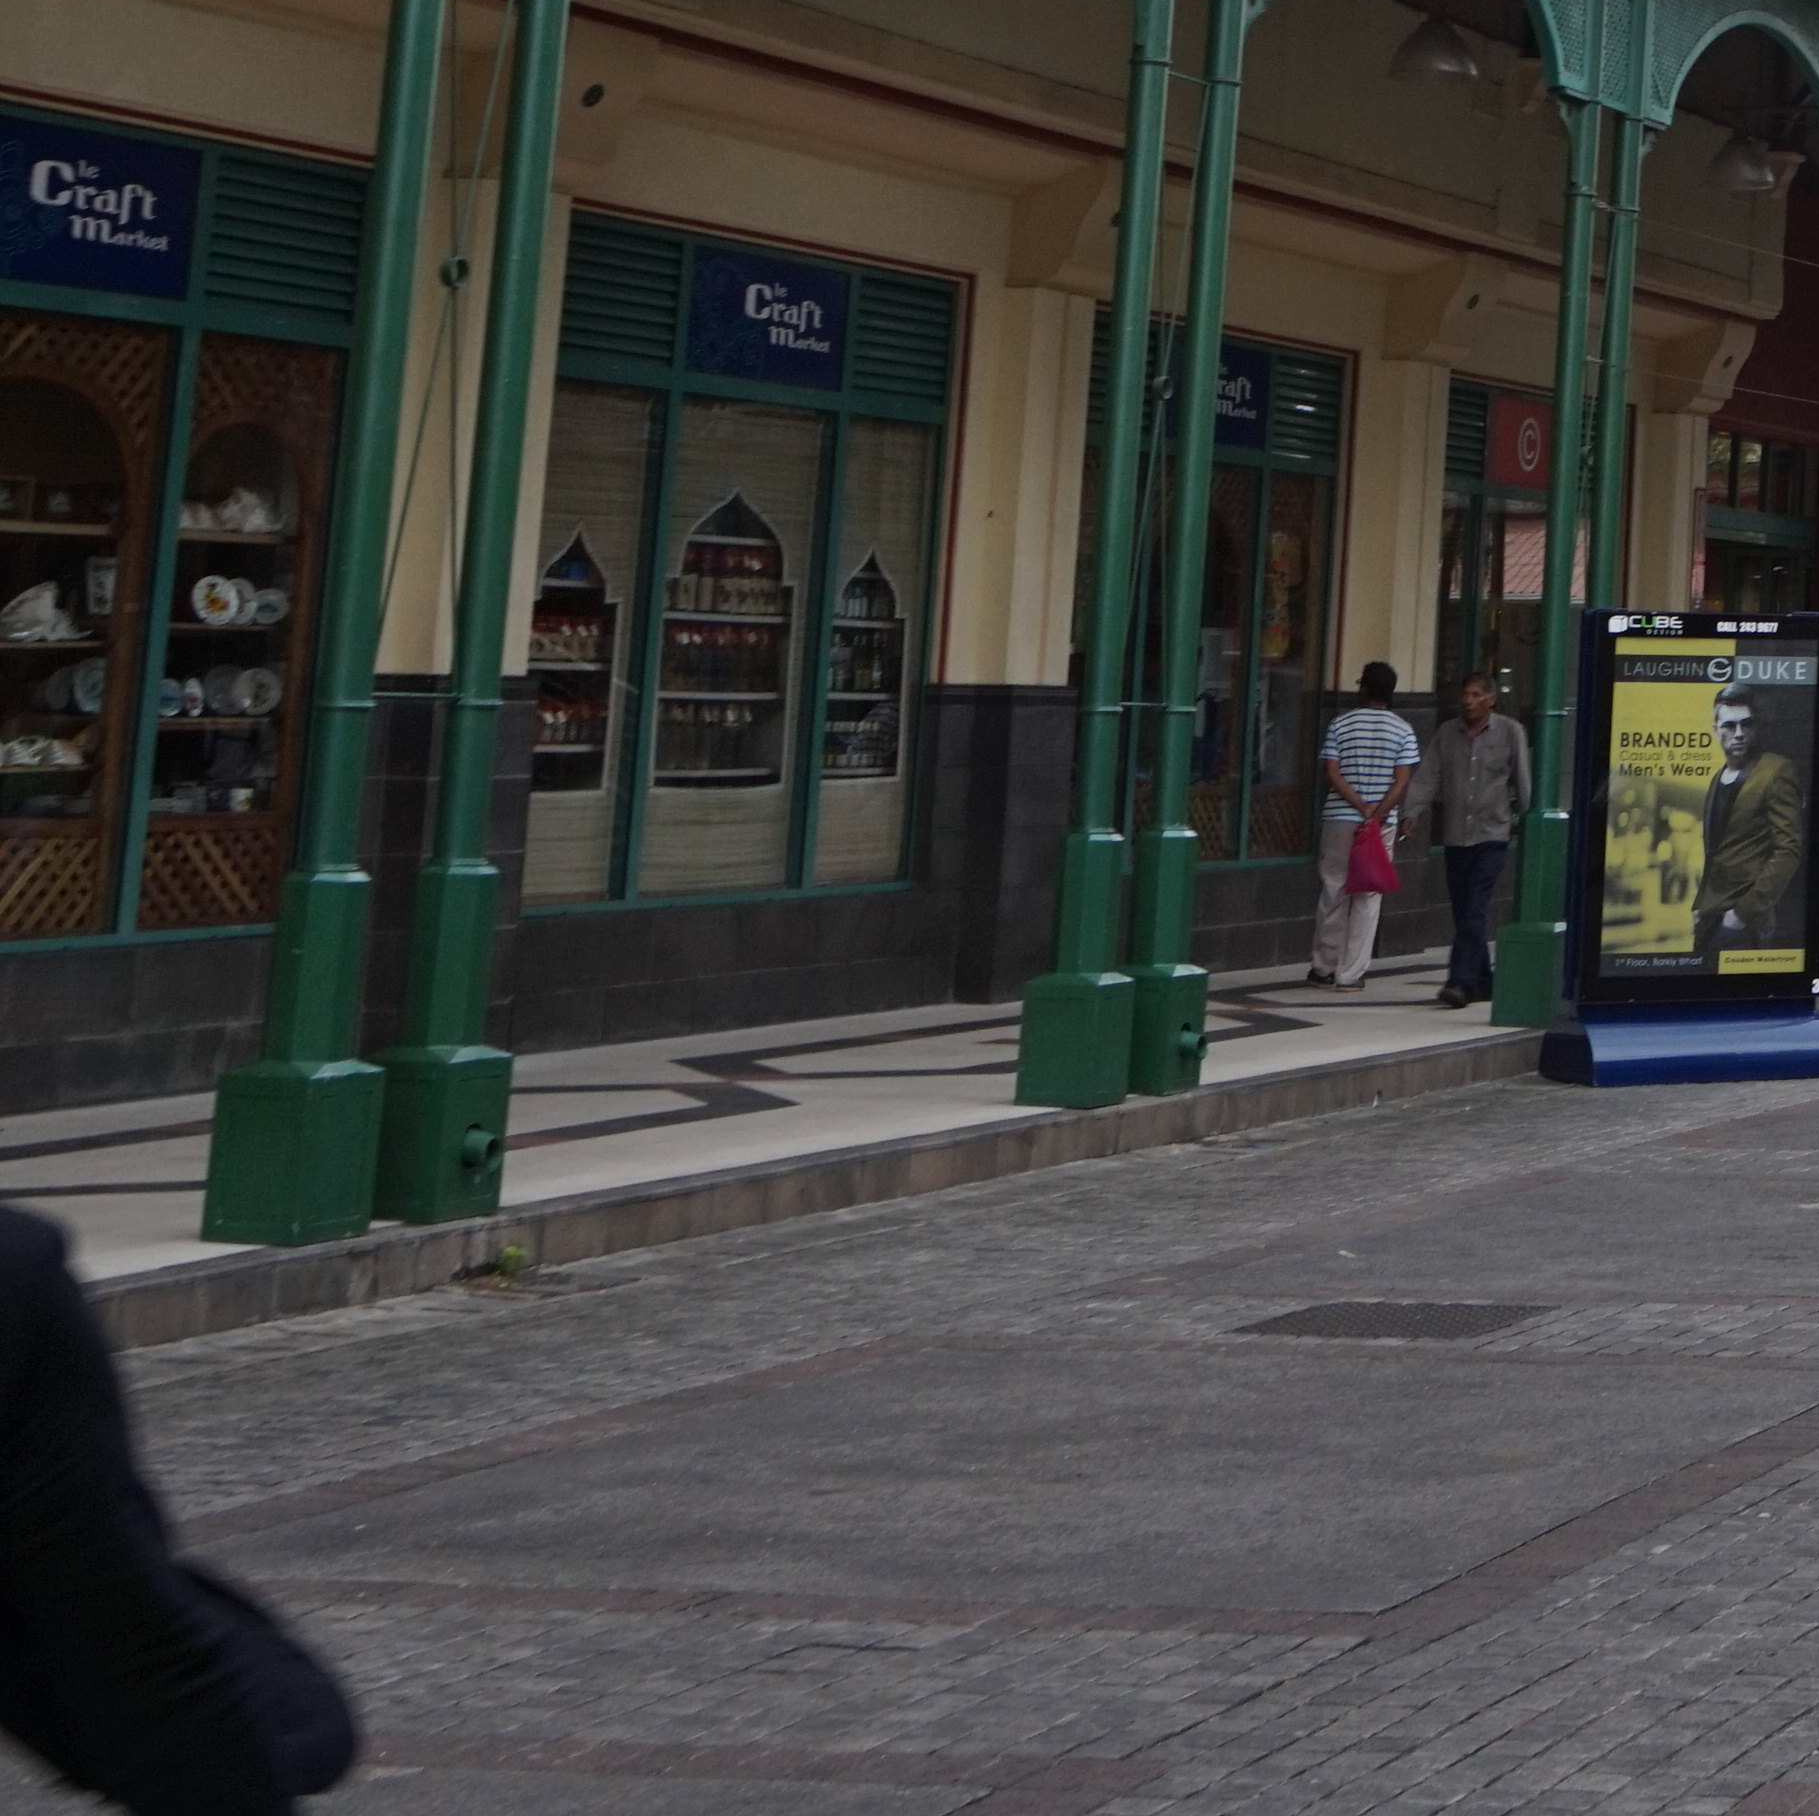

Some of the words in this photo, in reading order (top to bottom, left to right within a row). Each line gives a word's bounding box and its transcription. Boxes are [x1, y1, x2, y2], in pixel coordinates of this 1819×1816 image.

[77, 159, 101, 180] le
[29, 159, 158, 225] Craft
[68, 214, 171, 252] Market
[744, 283, 824, 334] Craft
[768, 325, 831, 353] Market
[1216, 376, 1252, 404] raft
[1628, 615, 1684, 629] CUBE
[1716, 621, 1738, 633] CALL
[1737, 661, 1808, 680] DUKE
[1620, 732, 1712, 748] BRANDED
[1620, 750, 1663, 762] Casual
[1681, 750, 1712, 762] dress
[1620, 763, 1665, 777] Men's
[1671, 763, 1712, 776] Wear
